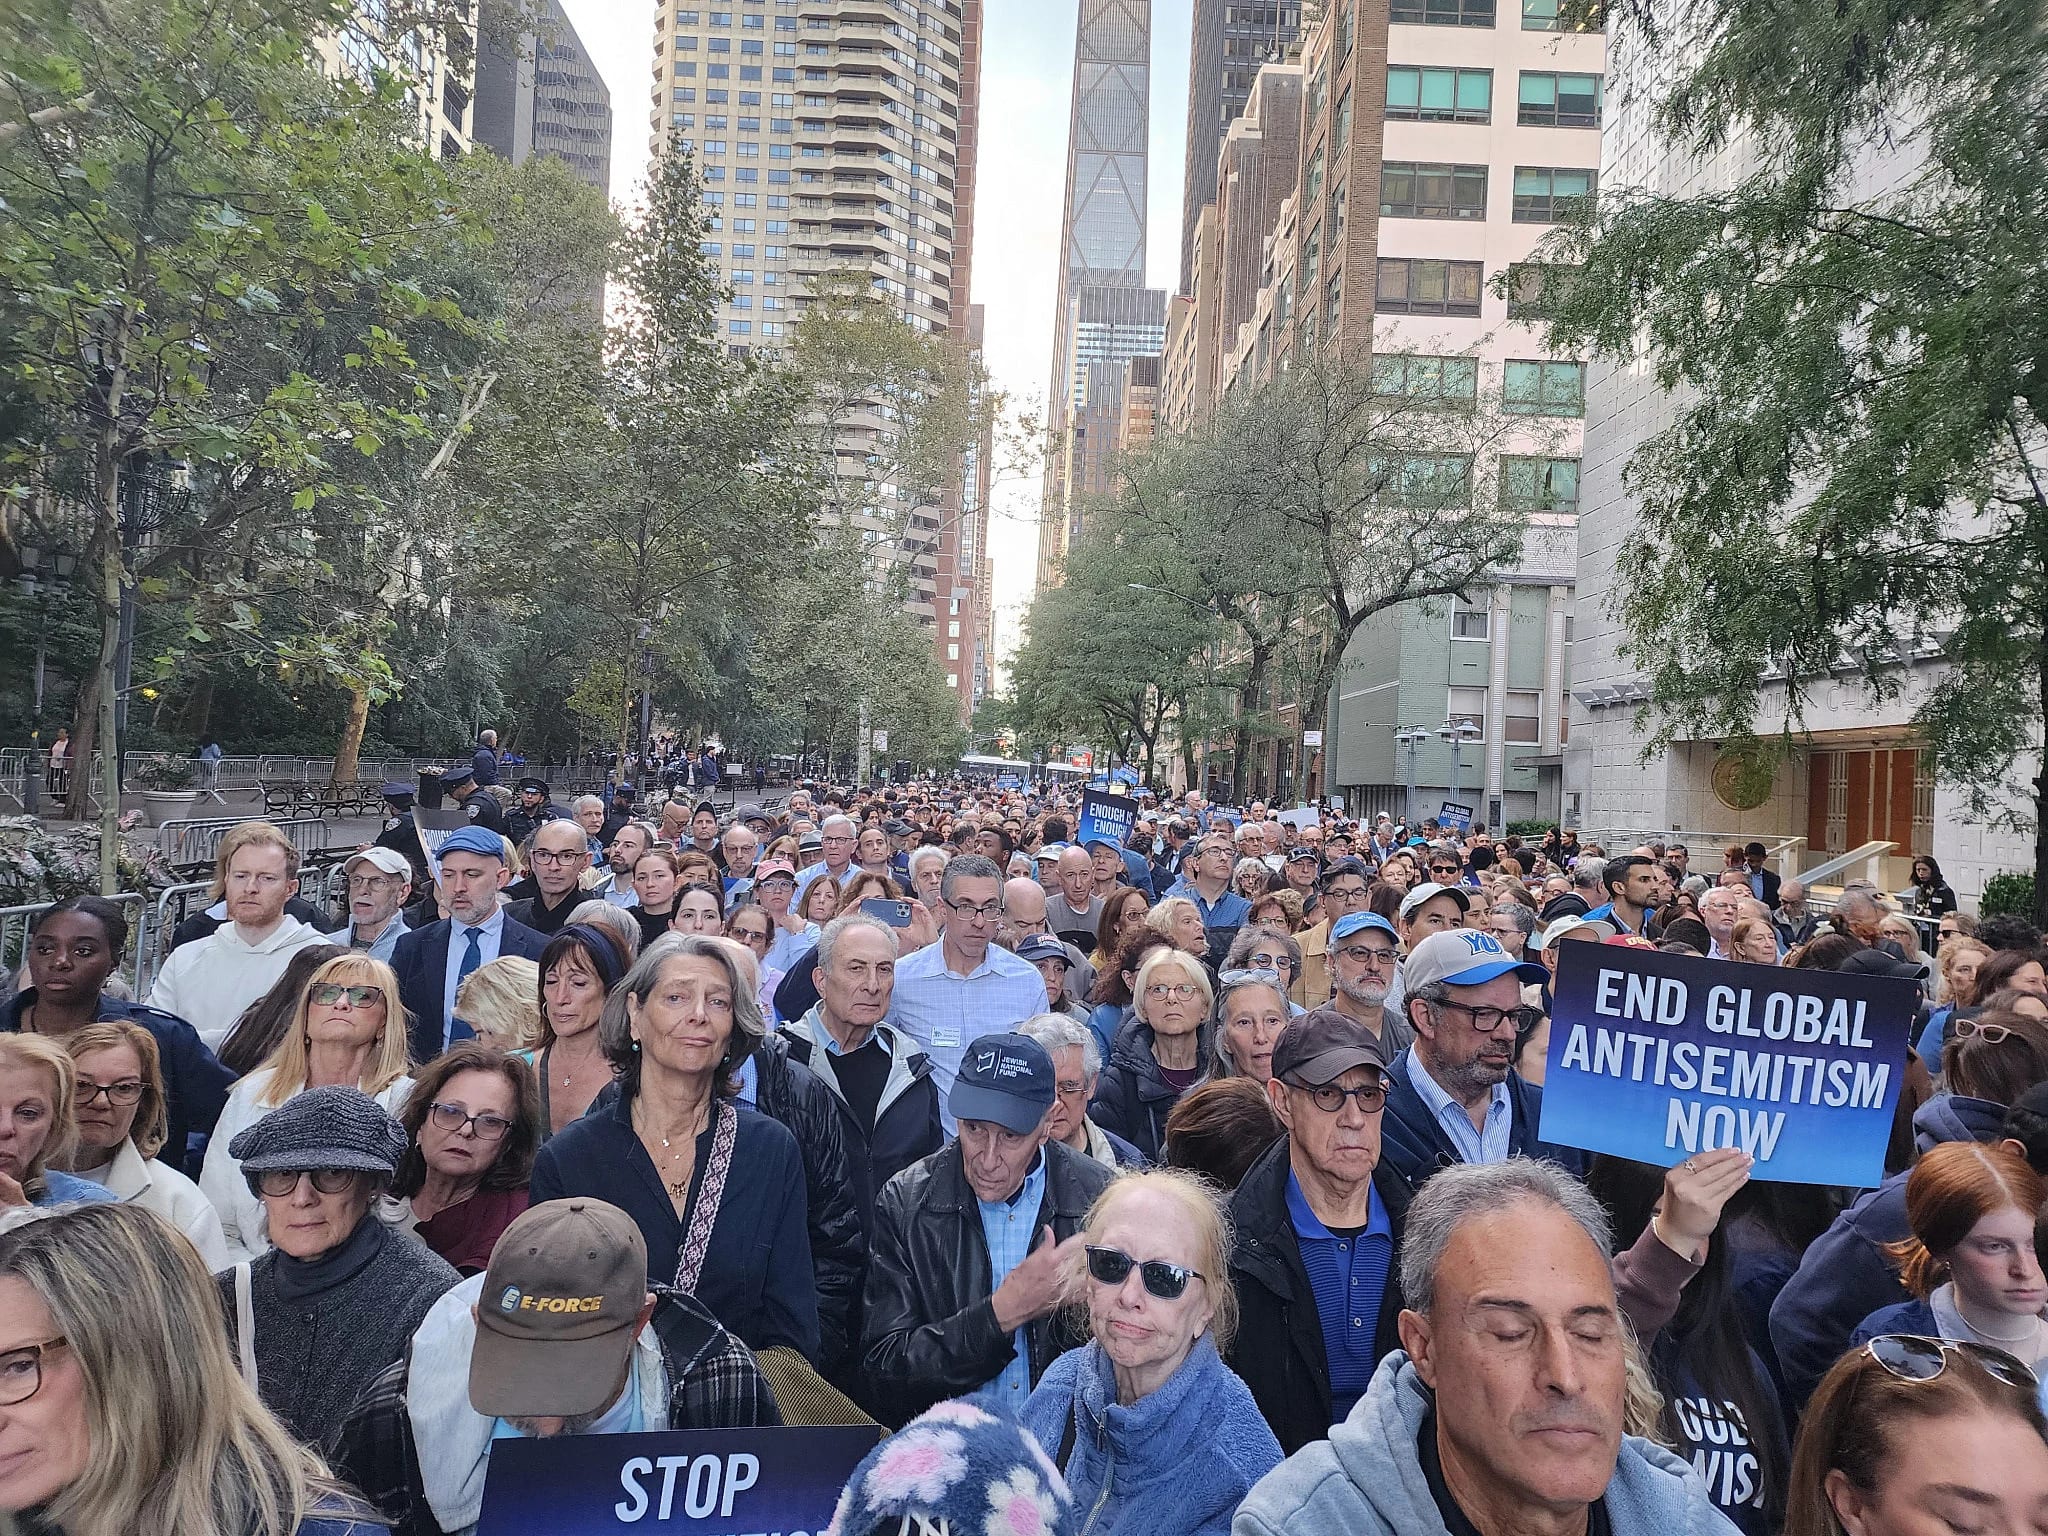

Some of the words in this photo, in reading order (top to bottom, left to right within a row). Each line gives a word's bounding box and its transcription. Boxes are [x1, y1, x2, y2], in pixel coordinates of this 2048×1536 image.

[1090, 802, 1125, 823] ENOUGH
[1126, 810, 1133, 826] IS
[1460, 932, 1502, 955] YU
[1595, 968, 1688, 1026] END
[1705, 985, 1873, 1048] GLOBAL
[999, 1069, 1017, 1077] FUND
[1000, 1063, 1034, 1076] NATIONAL
[1001, 1056, 1028, 1067] JEWISH
[1561, 1024, 1891, 1110] ANTISEMITISM
[1664, 1098, 1786, 1162] NOW
[519, 1294, 605, 1313] E-FORCE
[614, 1453, 760, 1522] STOP
